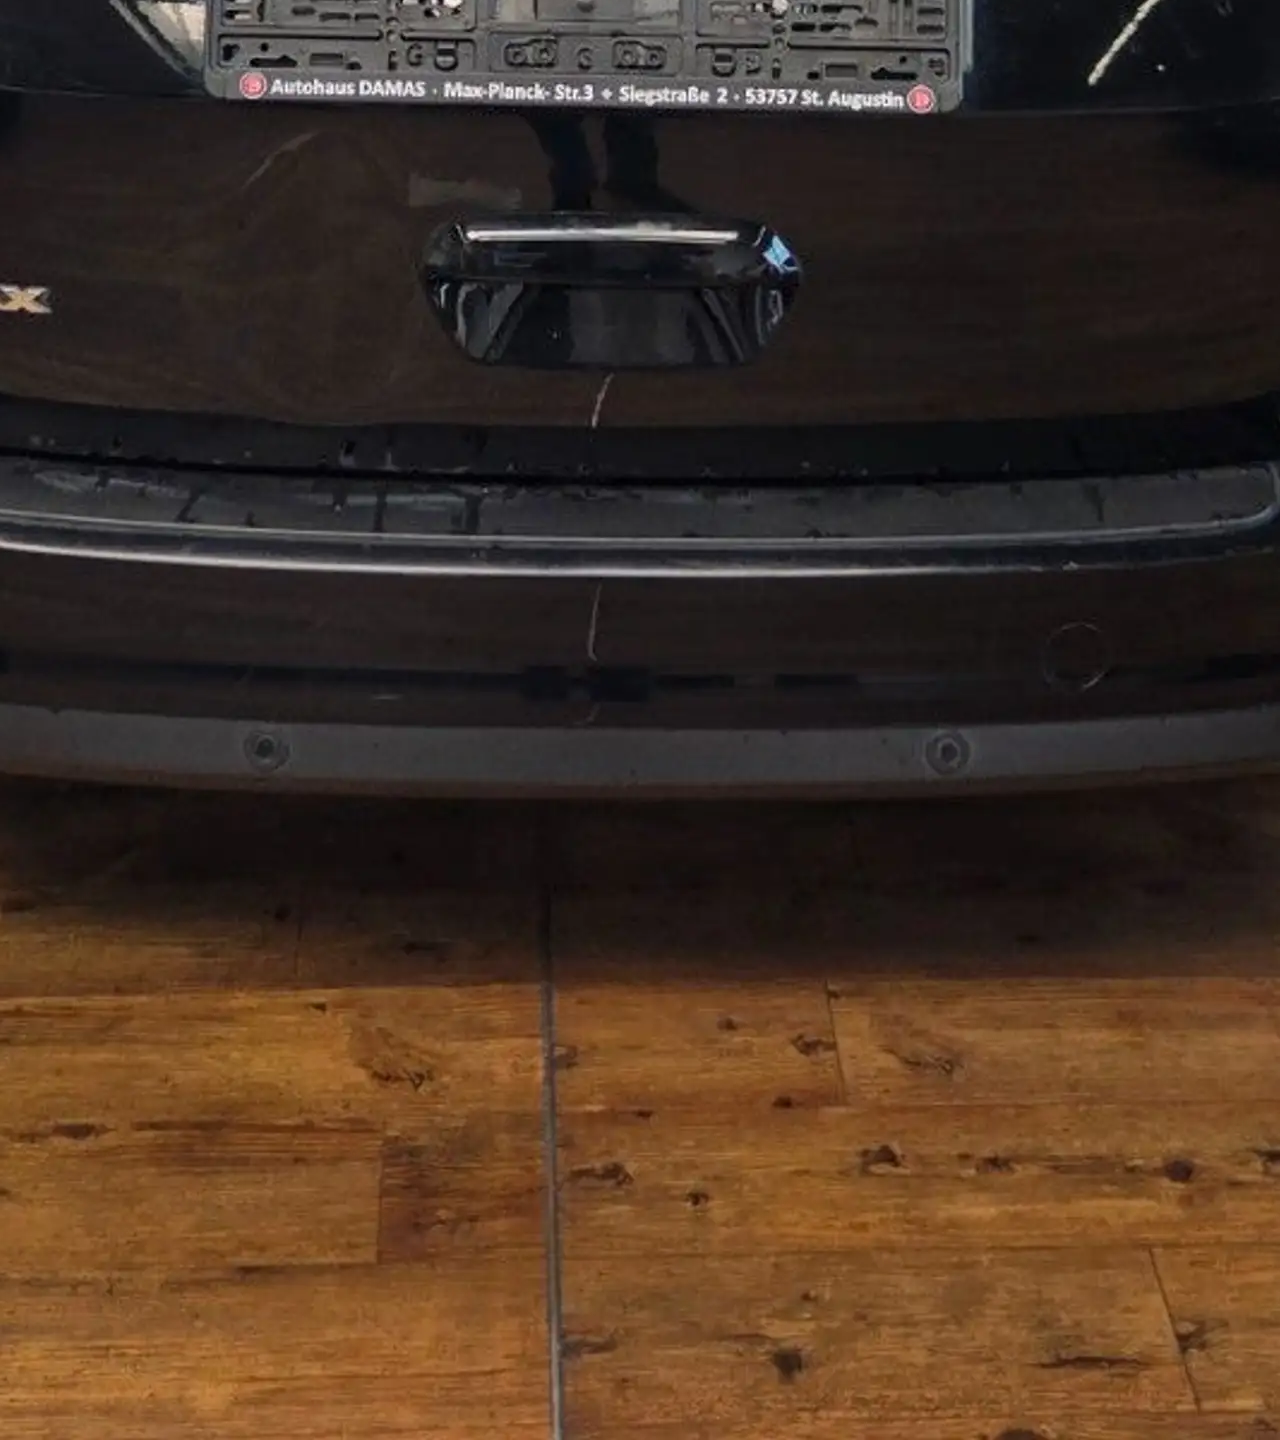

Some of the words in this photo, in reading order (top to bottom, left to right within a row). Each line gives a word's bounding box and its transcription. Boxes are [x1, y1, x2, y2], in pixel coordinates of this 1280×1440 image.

[271, 78, 356, 97] Autohaus
[359, 79, 426, 98] DAMAS
[619, 85, 709, 107] Siegstraße
[717, 87, 728, 103] 2
[745, 87, 797, 104] 53757
[800, 88, 823, 105] St.
[827, 88, 904, 110] Augustin
